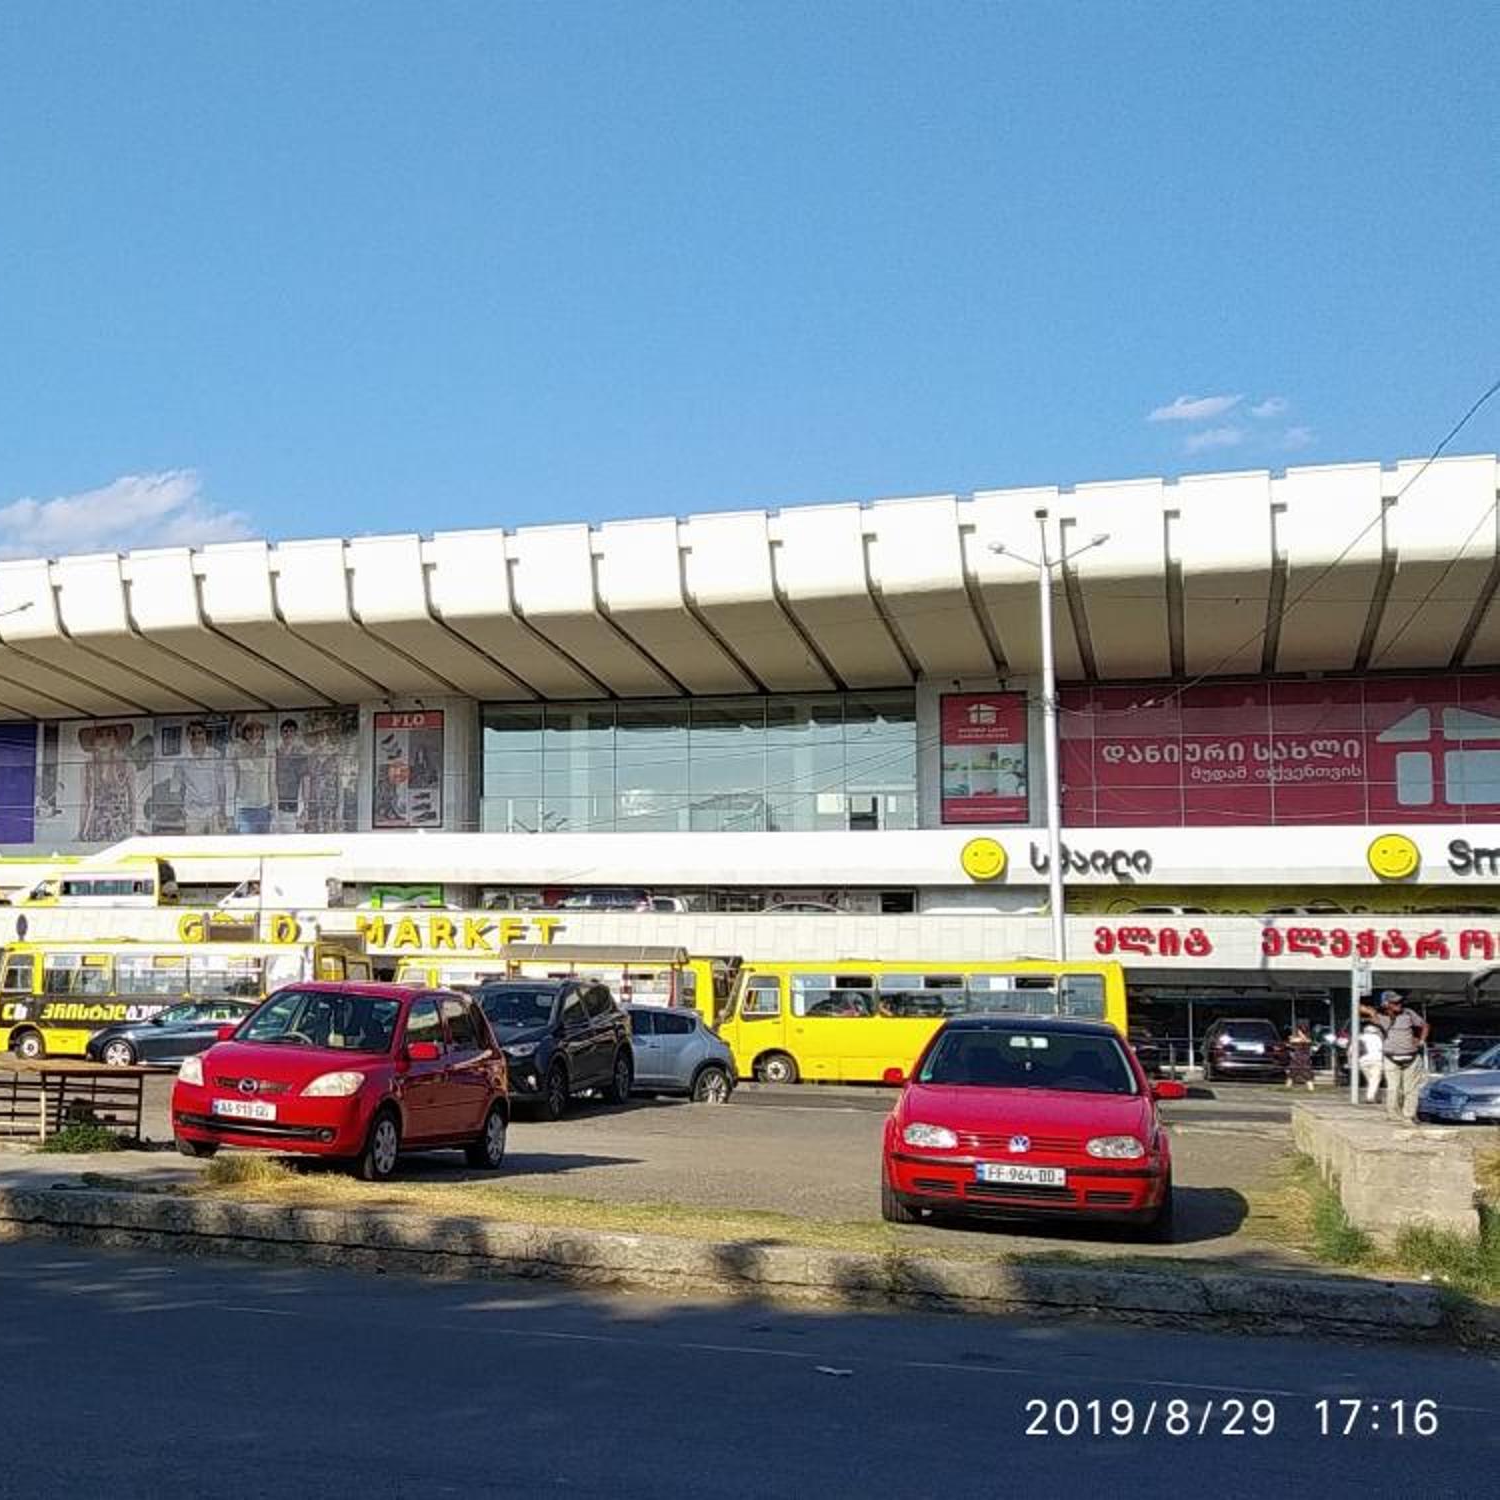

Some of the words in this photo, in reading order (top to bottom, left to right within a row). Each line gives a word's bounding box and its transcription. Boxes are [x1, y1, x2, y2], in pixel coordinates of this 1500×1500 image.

[391, 714, 426, 727] FLO
[1102, 742, 1244, 763] დანიური
[1253, 738, 1361, 761] სახლი
[176, 911, 299, 945] GD
[1094, 927, 1213, 957] ელიტ
